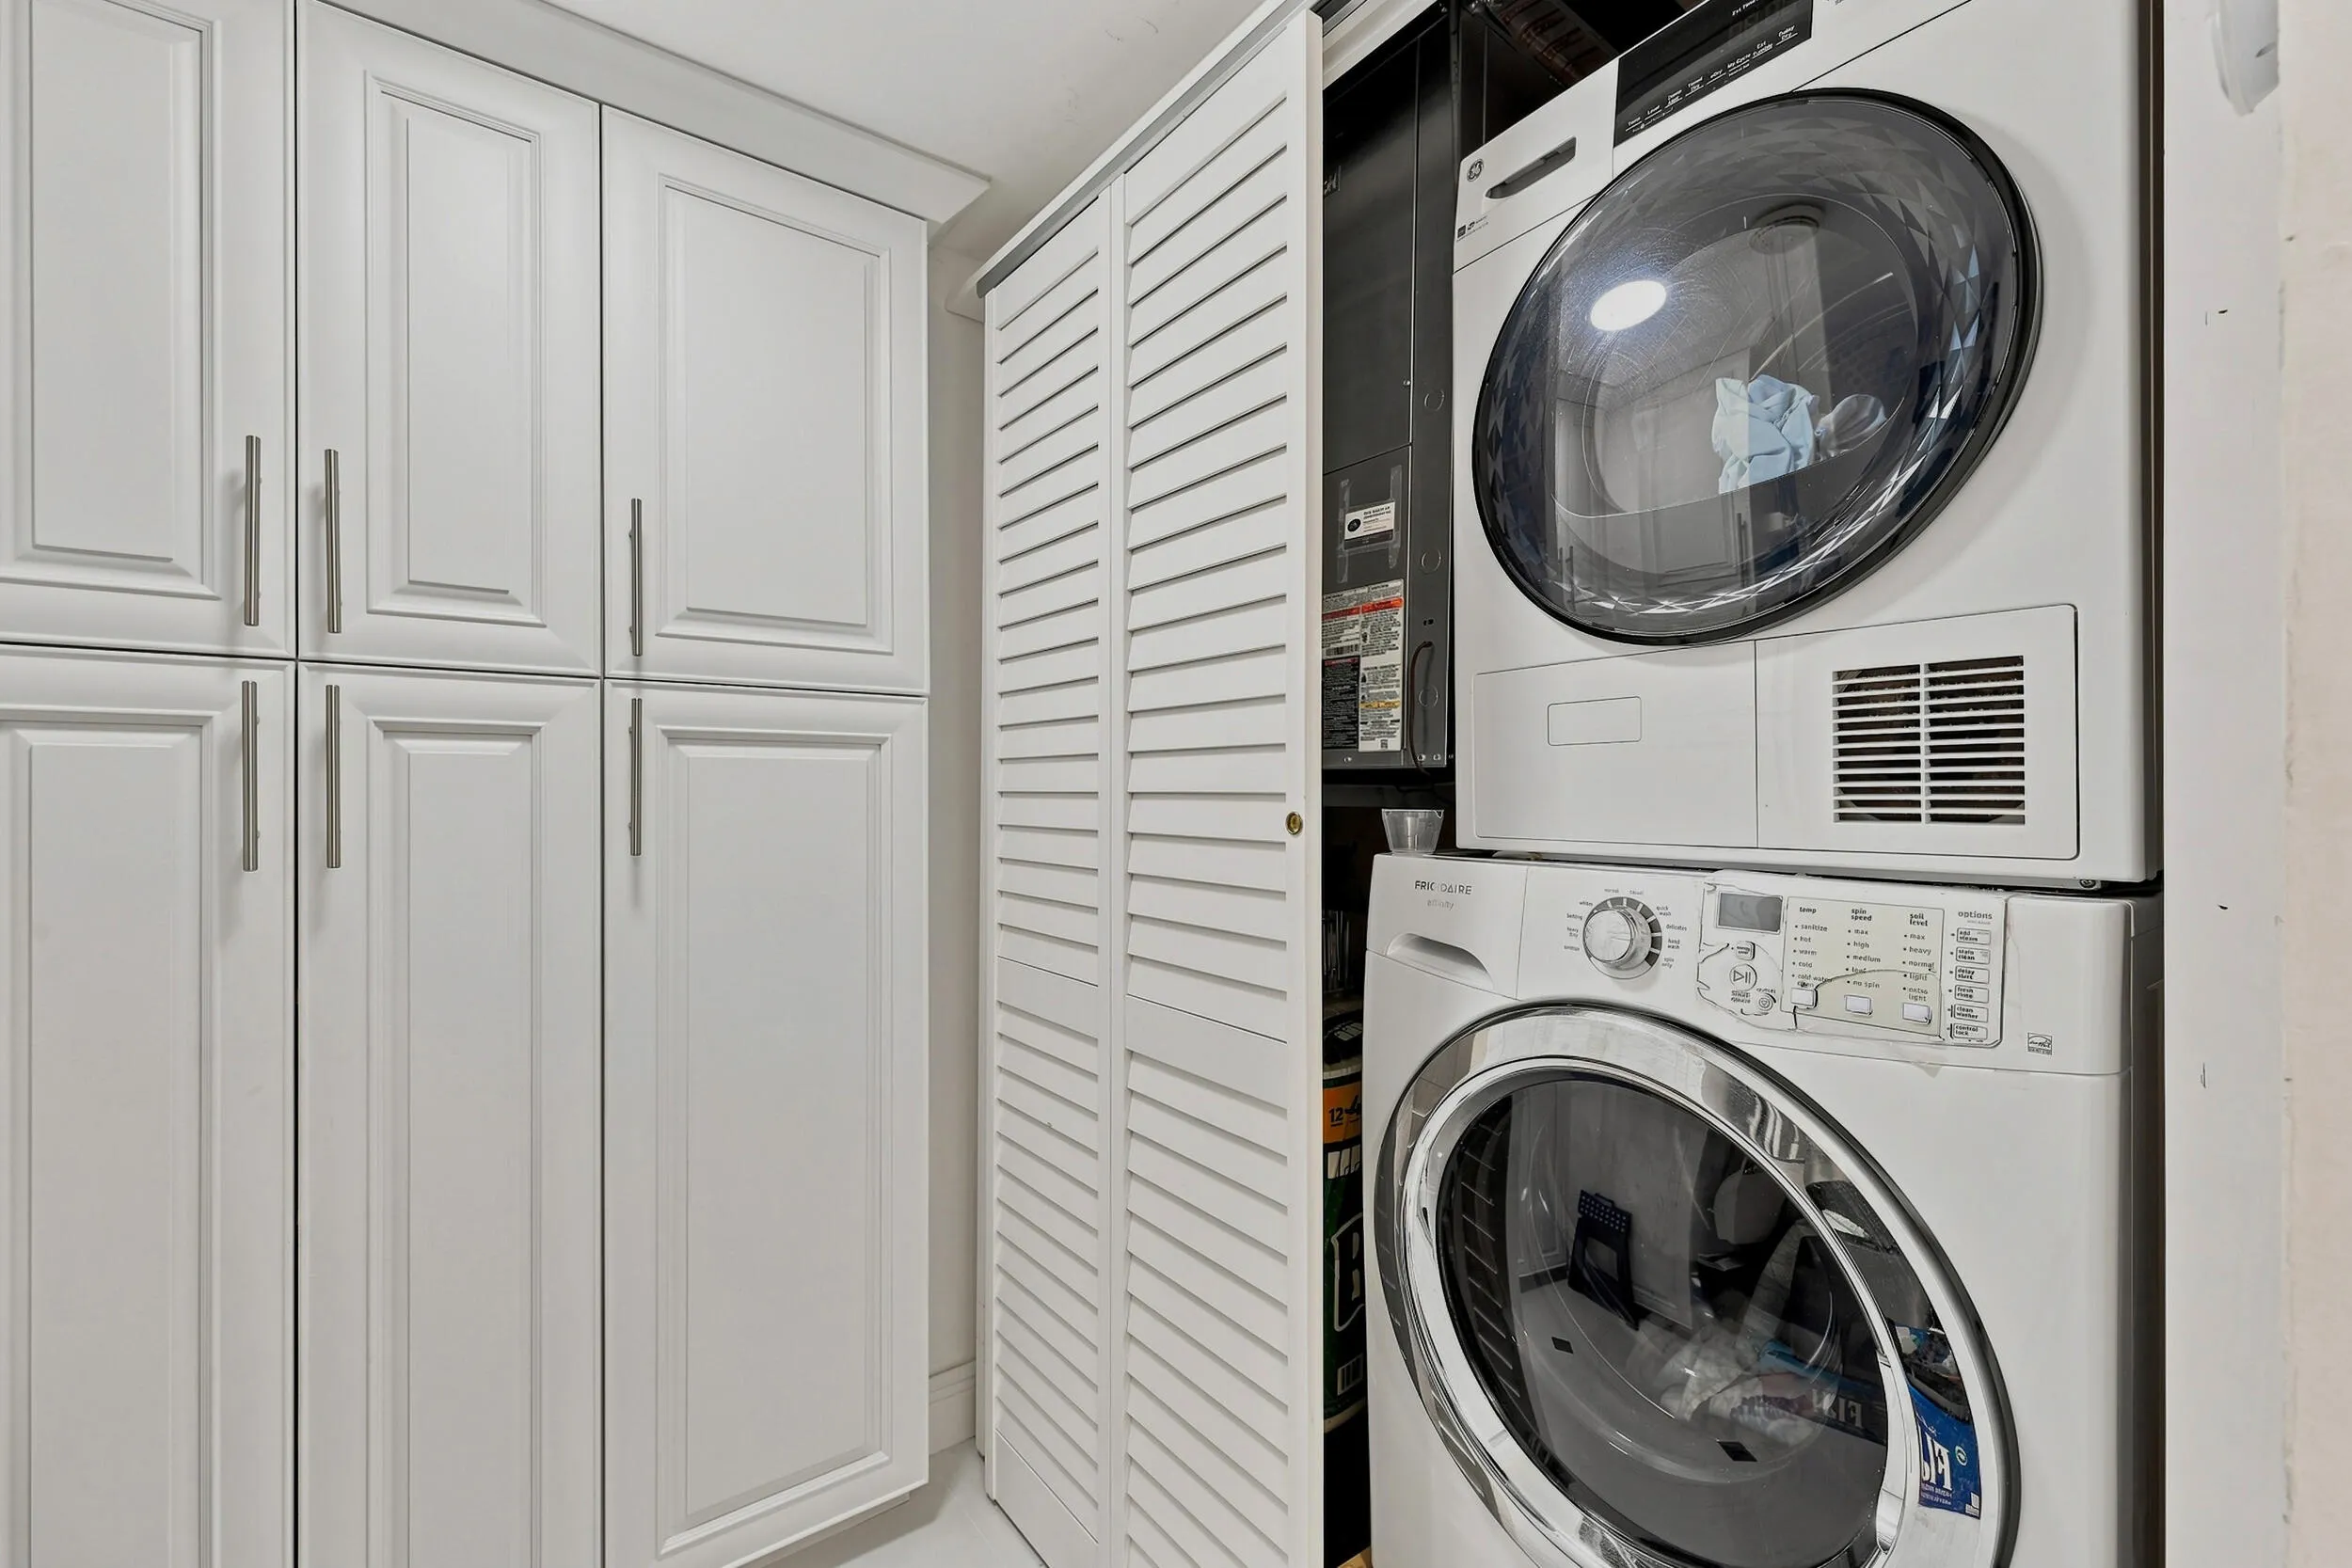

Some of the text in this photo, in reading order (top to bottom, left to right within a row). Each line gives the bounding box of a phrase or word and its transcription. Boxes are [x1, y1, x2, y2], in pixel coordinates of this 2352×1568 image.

[1799, 906, 1817, 914] temp
[1851, 908, 1867, 916] spin
[1958, 911, 1993, 920] options
[1801, 924, 1828, 932] sanitize
[1853, 941, 1869, 949] high
[1909, 945, 1931, 956] heavy
[1852, 954, 1881, 963] medium
[1864, 980, 1880, 990] spin
